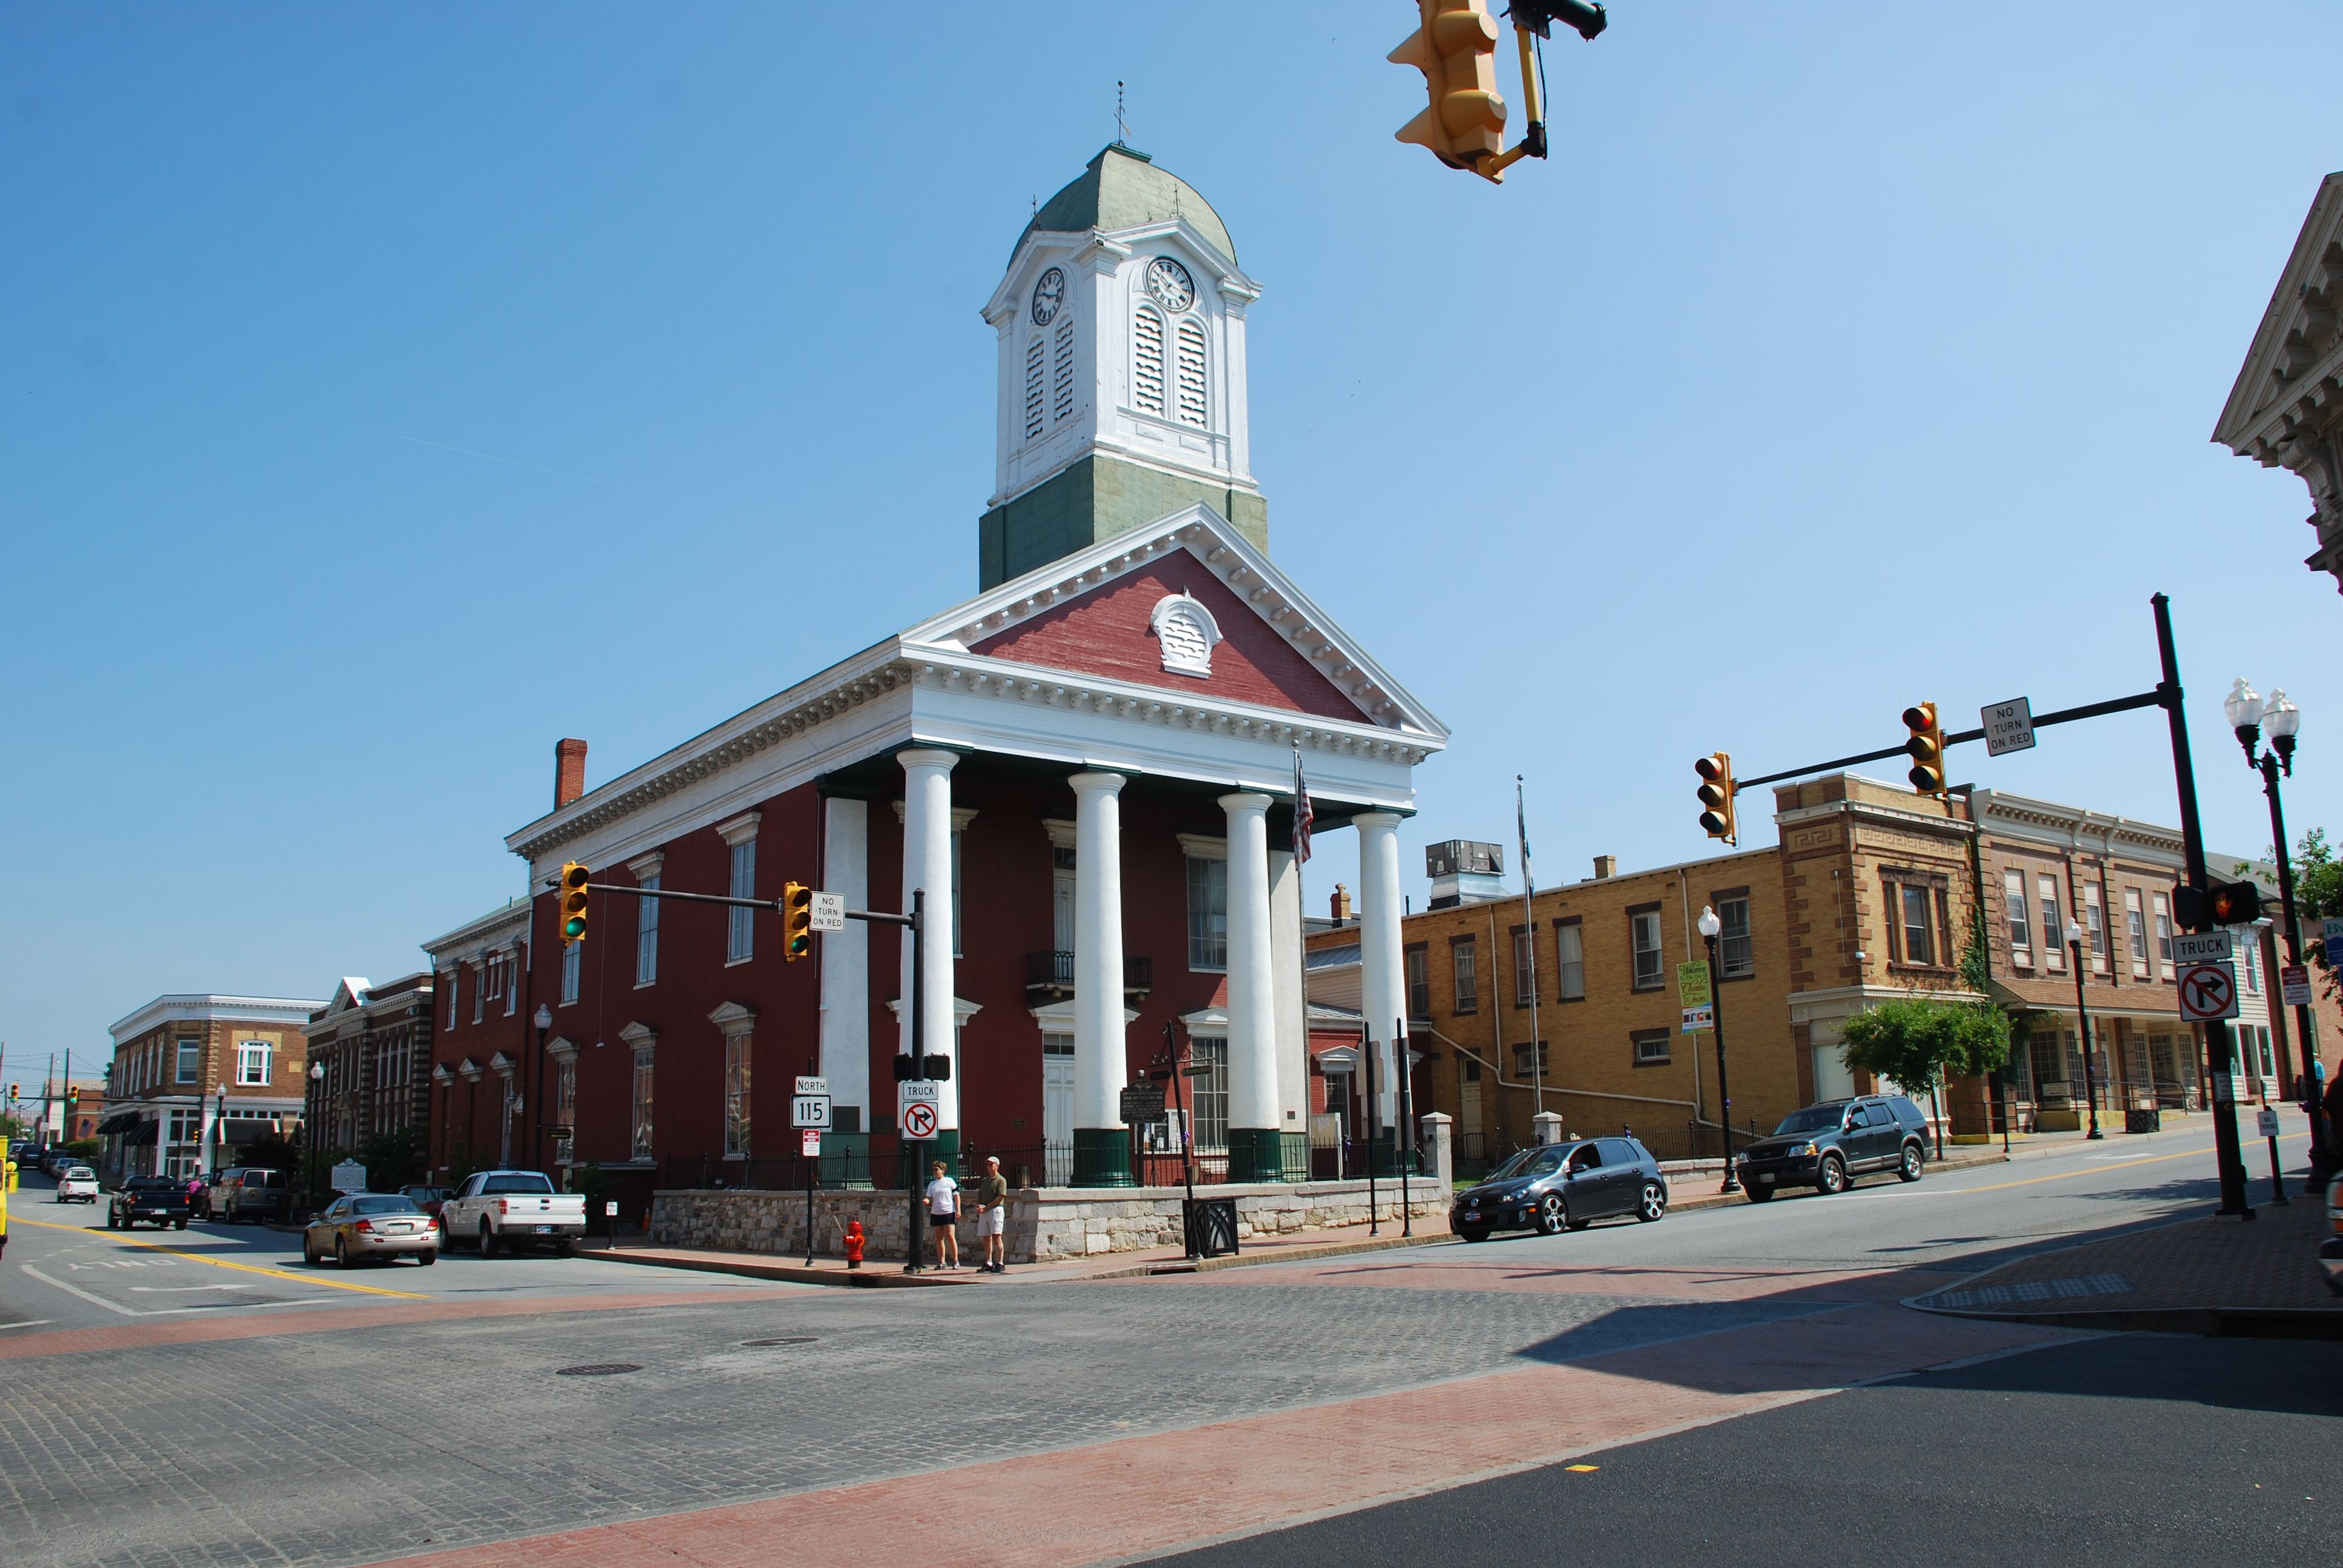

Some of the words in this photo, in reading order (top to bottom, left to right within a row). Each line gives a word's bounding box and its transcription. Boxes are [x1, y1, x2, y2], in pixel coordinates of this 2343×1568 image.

[1996, 707, 2014, 719] NO
[1993, 719, 2022, 734] TURN
[1991, 738, 2005, 750] ON
[2009, 732, 2030, 745] RED
[818, 907, 838, 916] TURN
[827, 918, 842, 927] RED
[2180, 938, 2224, 955] TRUCK
[1678, 961, 1706, 976] Welcome
[1680, 978, 1709, 994] Charles
[1683, 993, 1706, 1006] Town
[798, 1080, 825, 1091] NORTH
[908, 1086, 934, 1096] TRUCK
[799, 1102, 823, 1120] 115
